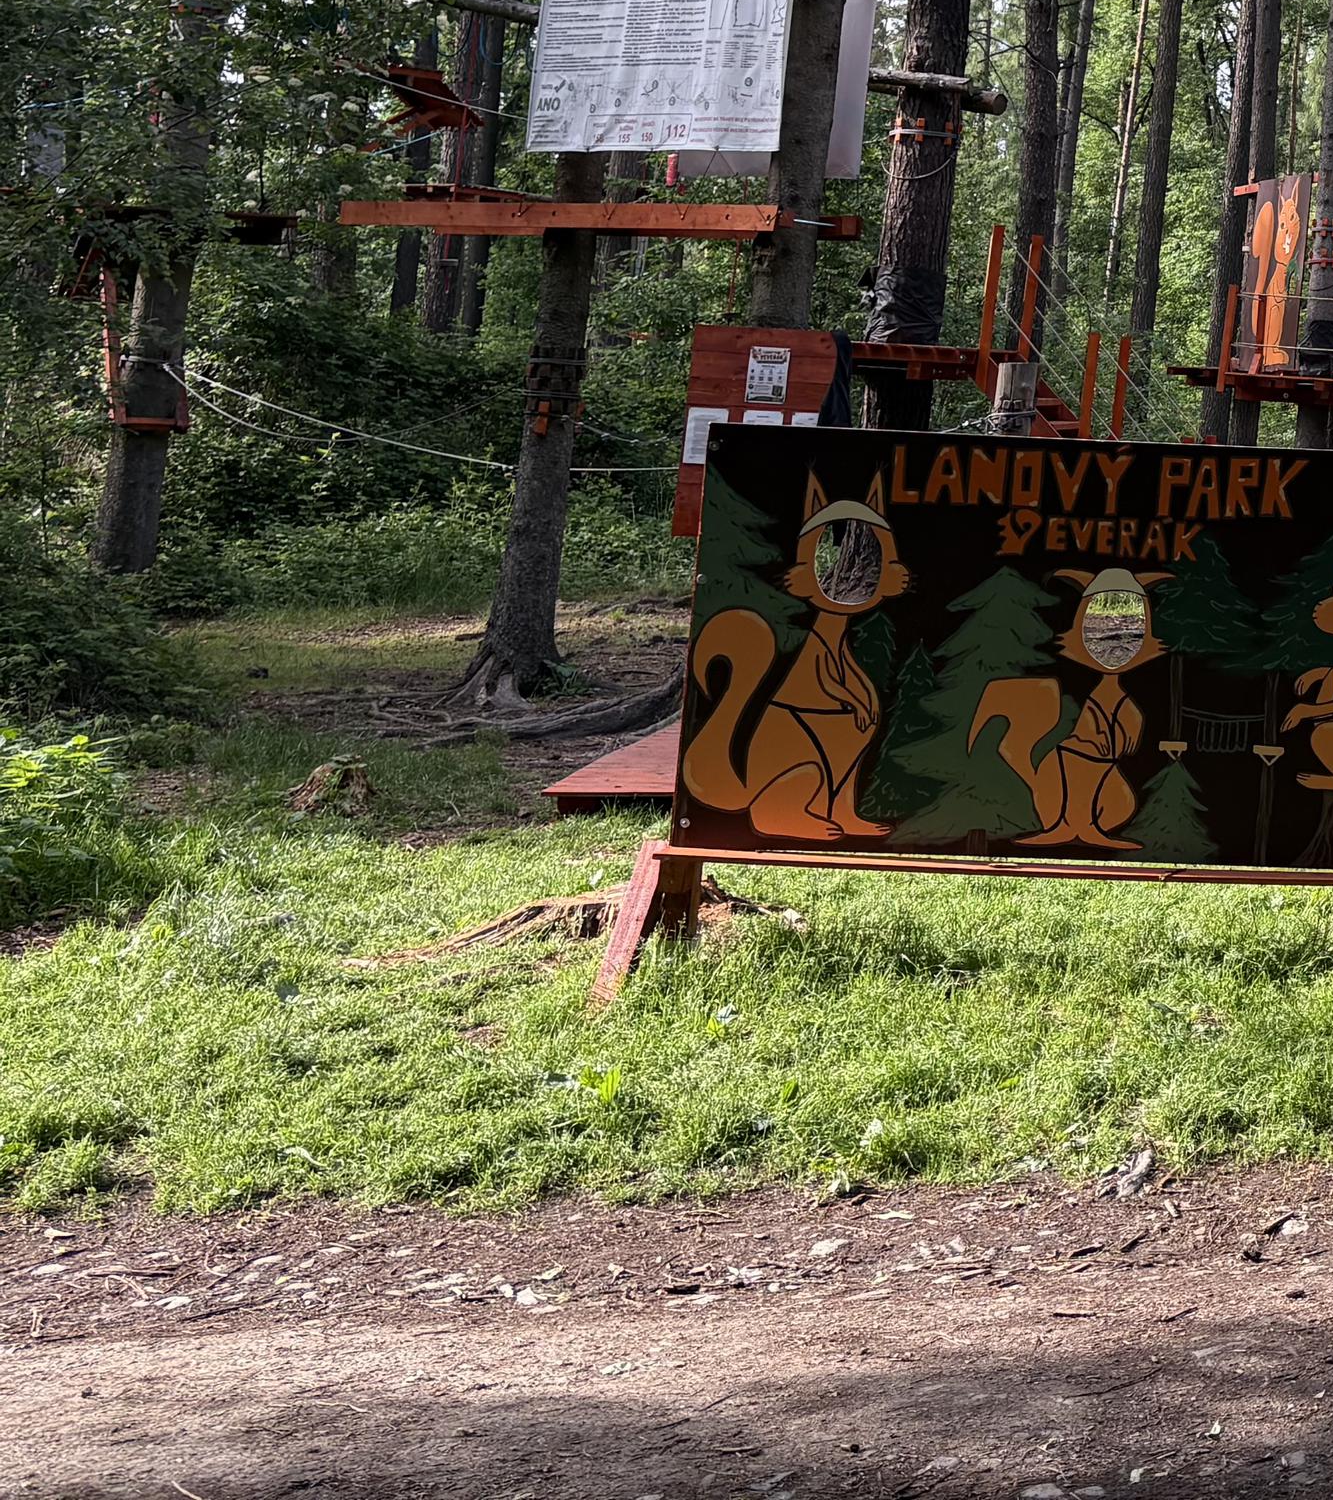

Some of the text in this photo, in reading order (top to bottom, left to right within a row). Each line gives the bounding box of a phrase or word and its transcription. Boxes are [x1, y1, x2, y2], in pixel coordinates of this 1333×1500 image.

[536, 97, 561, 112] ANO
[618, 133, 631, 143] 155
[666, 124, 686, 138] 112
[890, 443, 1310, 520] LANOVÝ PARK
